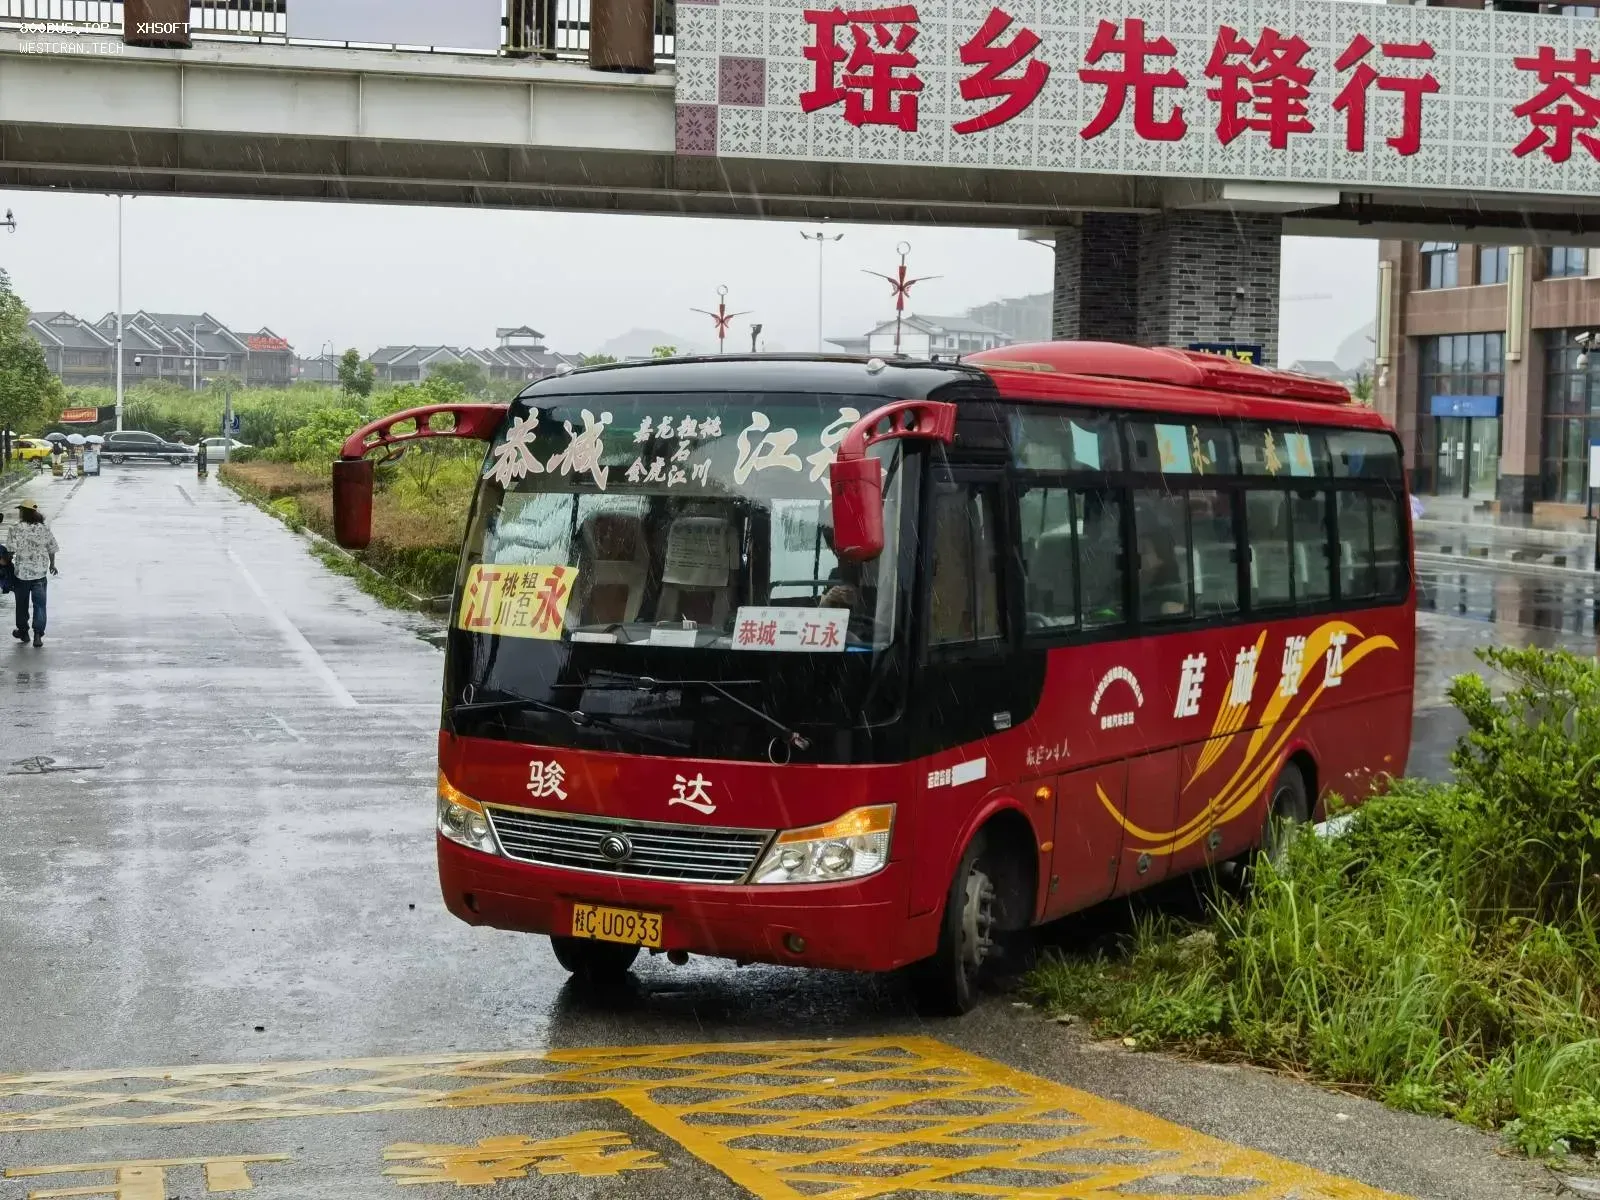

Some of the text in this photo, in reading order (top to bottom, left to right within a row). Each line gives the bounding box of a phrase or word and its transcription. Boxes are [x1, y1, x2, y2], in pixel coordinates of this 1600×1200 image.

[799, 4, 1600, 164] 瑶乡先锋行 茶
[483, 407, 613, 490] 恭城
[526, 759, 717, 815] 骏达
